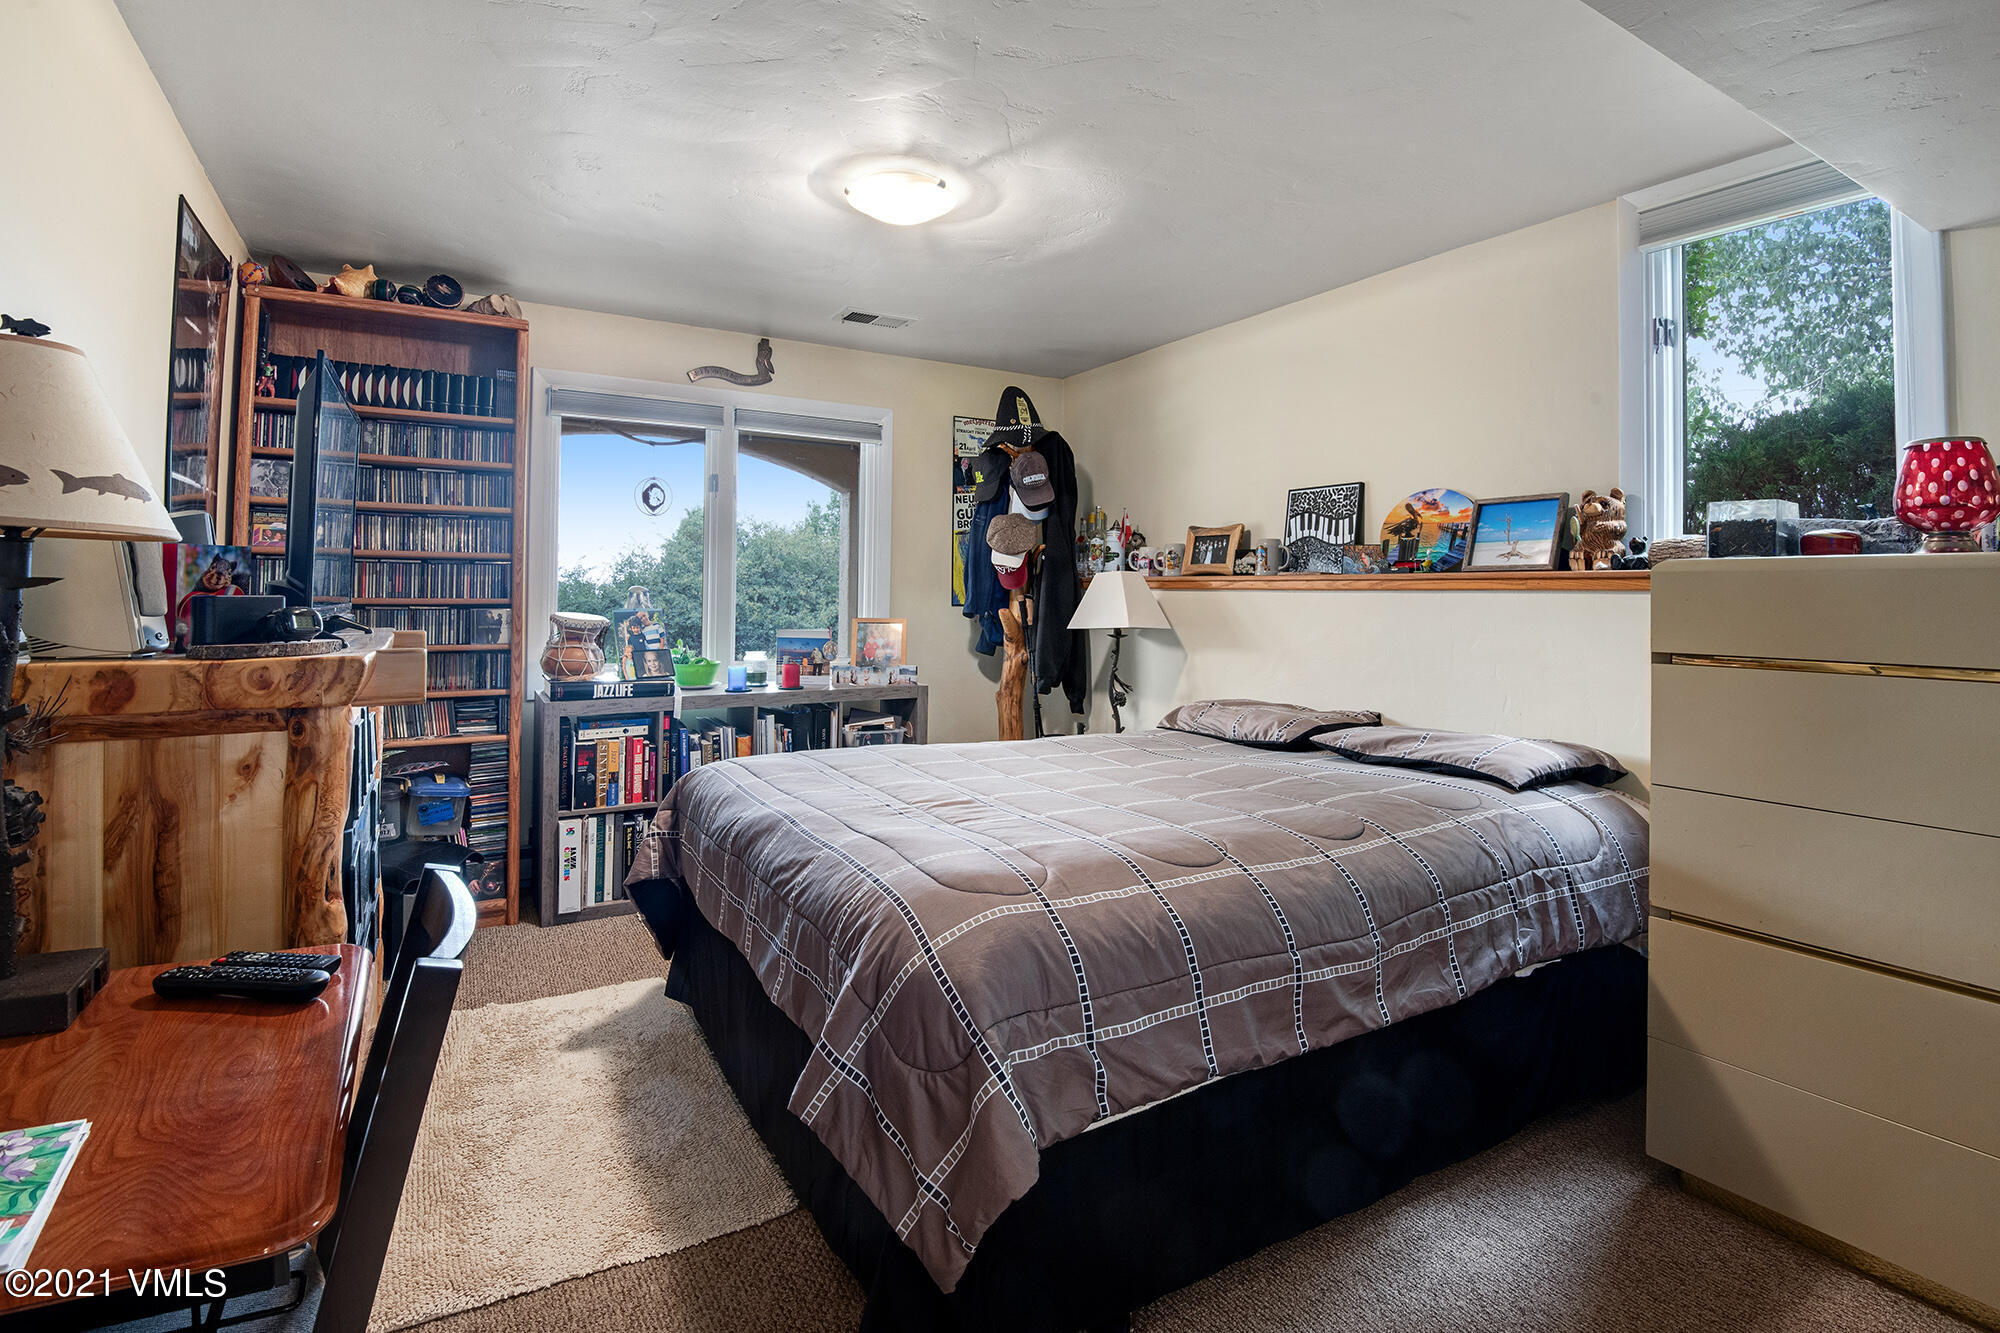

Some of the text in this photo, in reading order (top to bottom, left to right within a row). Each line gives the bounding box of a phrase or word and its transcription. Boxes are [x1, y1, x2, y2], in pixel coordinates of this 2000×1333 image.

[959, 442, 967, 450] 21
[955, 495, 975, 504] NEU
[956, 508, 976, 520] GU
[592, 683, 634, 699] JAZZ LIFE
[599, 744, 608, 797] SINATRA
[563, 846, 571, 882] COVERS
